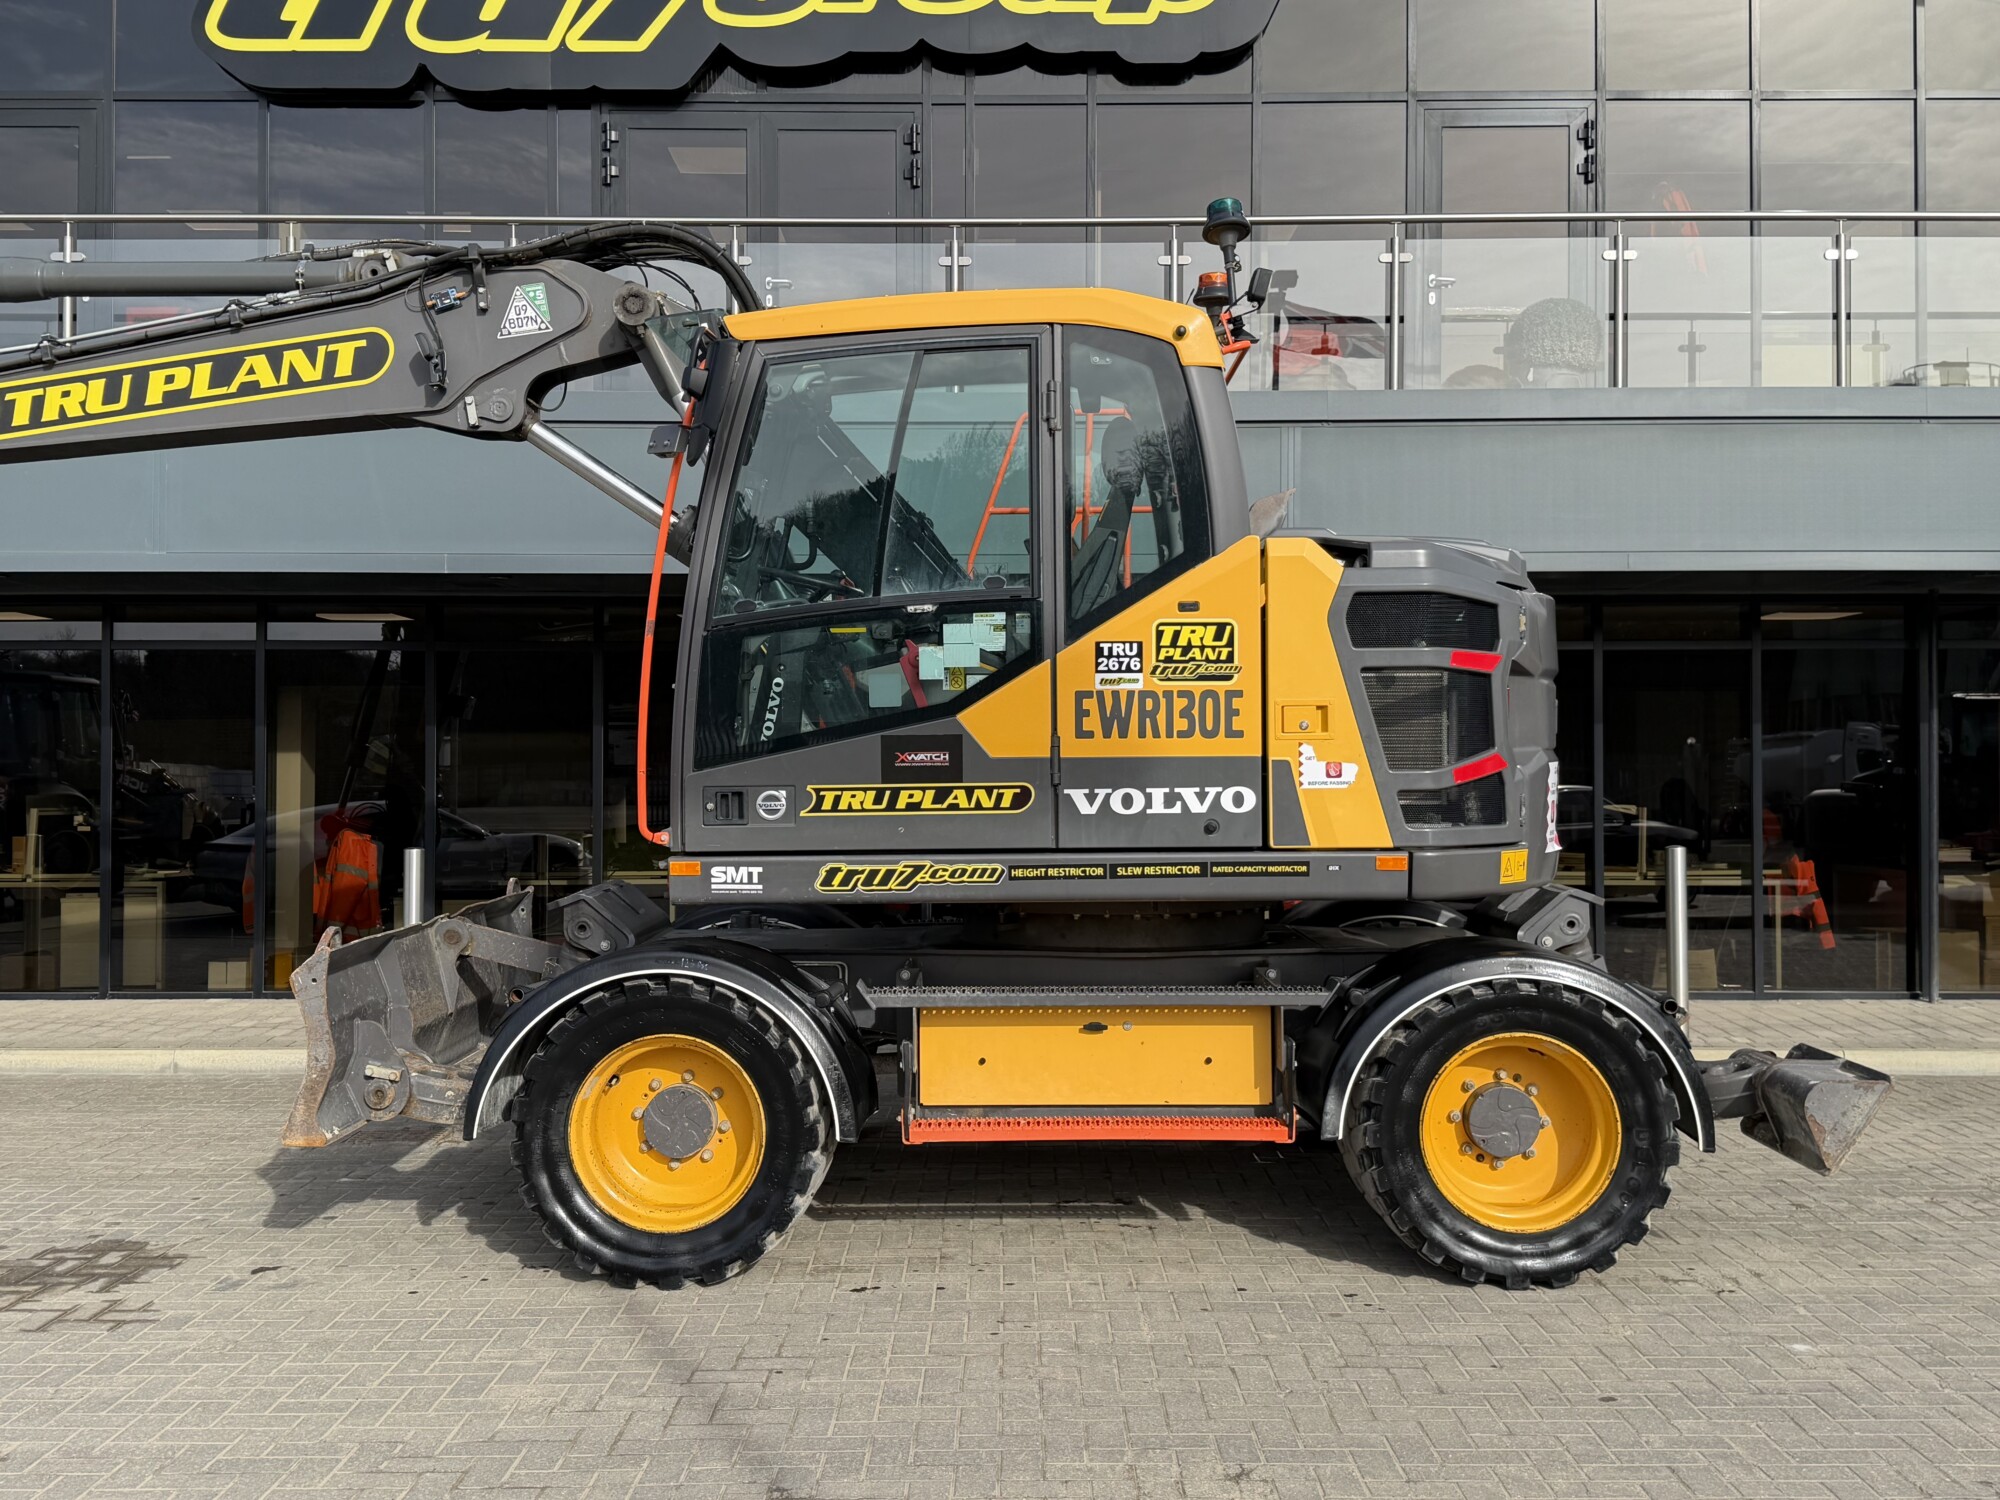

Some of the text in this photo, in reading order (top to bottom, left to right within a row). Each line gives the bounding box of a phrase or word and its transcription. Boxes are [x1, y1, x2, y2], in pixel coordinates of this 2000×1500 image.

[535, 290, 544, 299] 5
[514, 304, 528, 316] 09
[4, 339, 367, 427] TRU PLANT
[1157, 625, 1232, 647] TRU
[1099, 643, 1138, 656] TRU
[1157, 648, 1232, 661] PLANT
[1097, 657, 1141, 671] 2676
[1149, 661, 1242, 679] tru7.com
[1074, 689, 1245, 739] EWR130E
[895, 752, 949, 762] XWATCH
[819, 788, 1020, 810] TRU PLANT
[1064, 786, 1257, 814] VOLVO
[710, 866, 763, 883] SMT
[816, 861, 1005, 893] tru7.com
[1011, 867, 1104, 877] HEIGHT RESTRICTOR
[1116, 865, 1201, 876] SLEW RESTRICTOR
